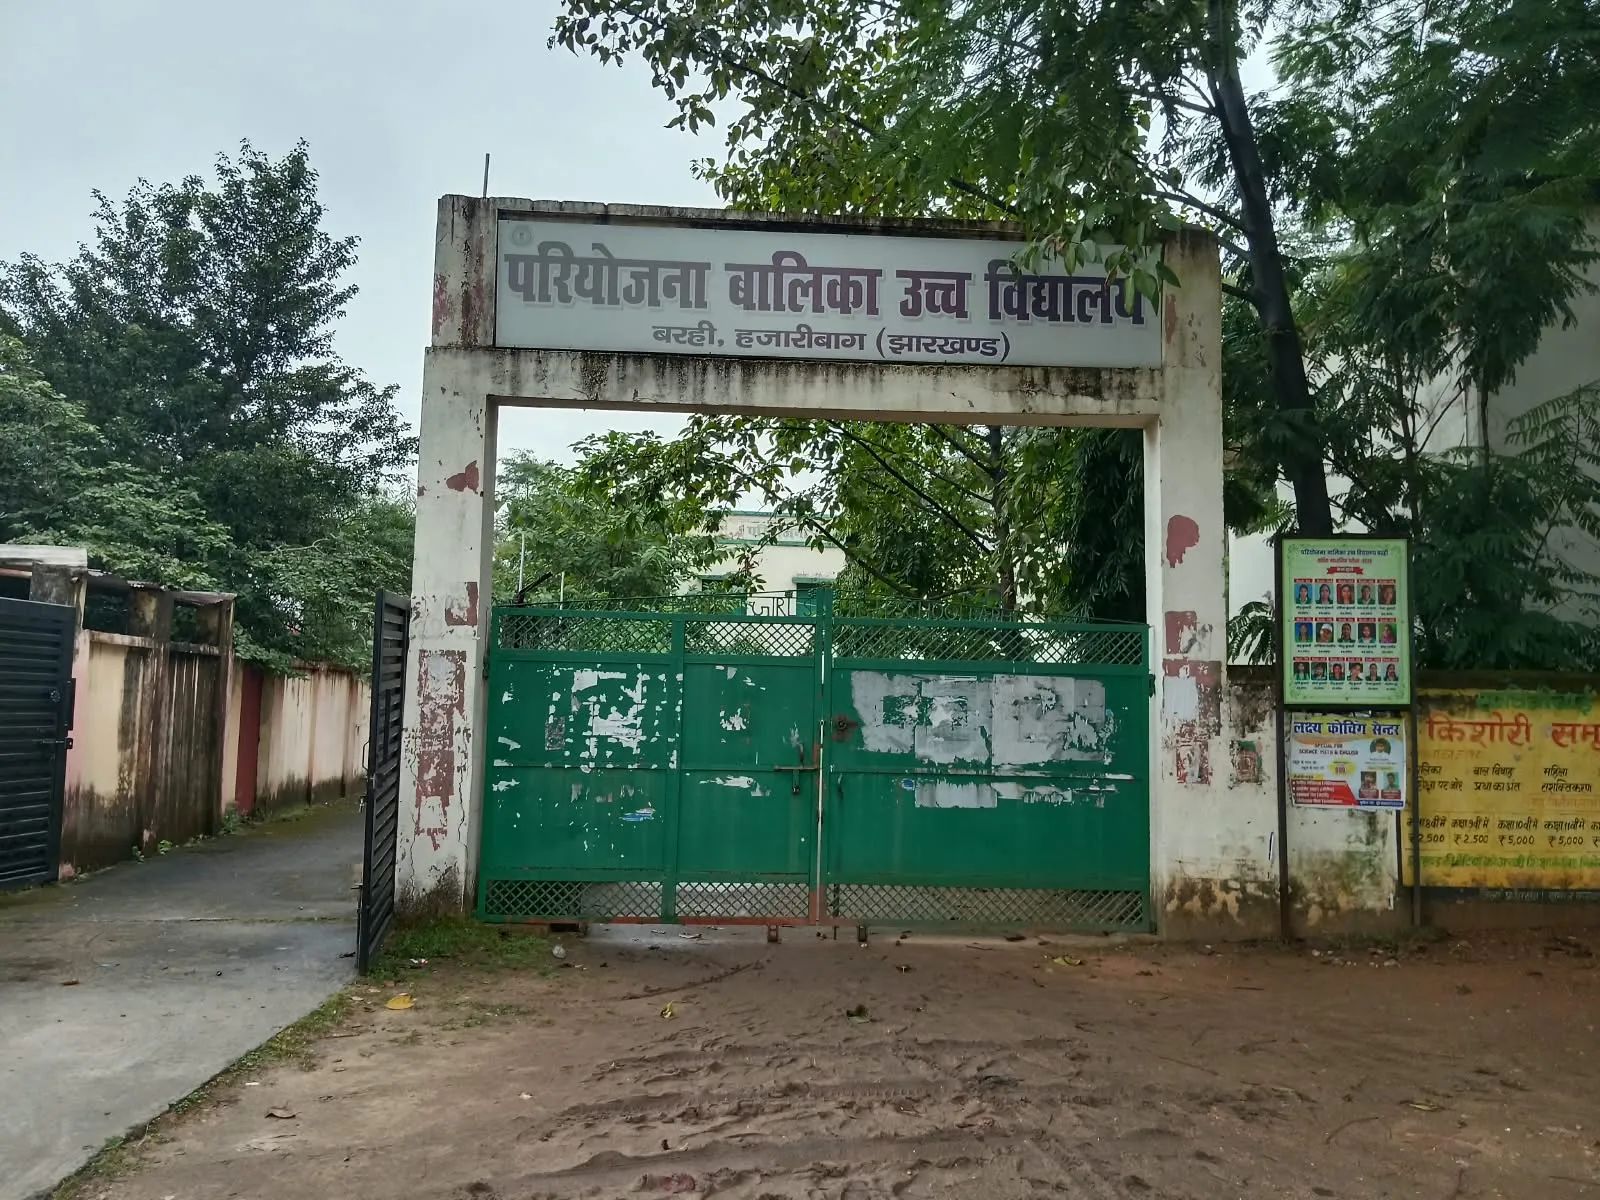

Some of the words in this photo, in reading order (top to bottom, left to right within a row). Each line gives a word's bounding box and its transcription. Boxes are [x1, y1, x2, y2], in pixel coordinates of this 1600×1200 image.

[504, 241, 711, 309] परियोजना
[724, 250, 882, 316] बालिका
[896, 269, 972, 318] उच्च
[652, 320, 724, 348] बरही,
[735, 323, 867, 350] हजारीबाग
[875, 327, 1011, 362] (झारखण्ड)
[1426, 711, 1532, 748] किशोरी
[1544, 764, 1568, 779] महिला
